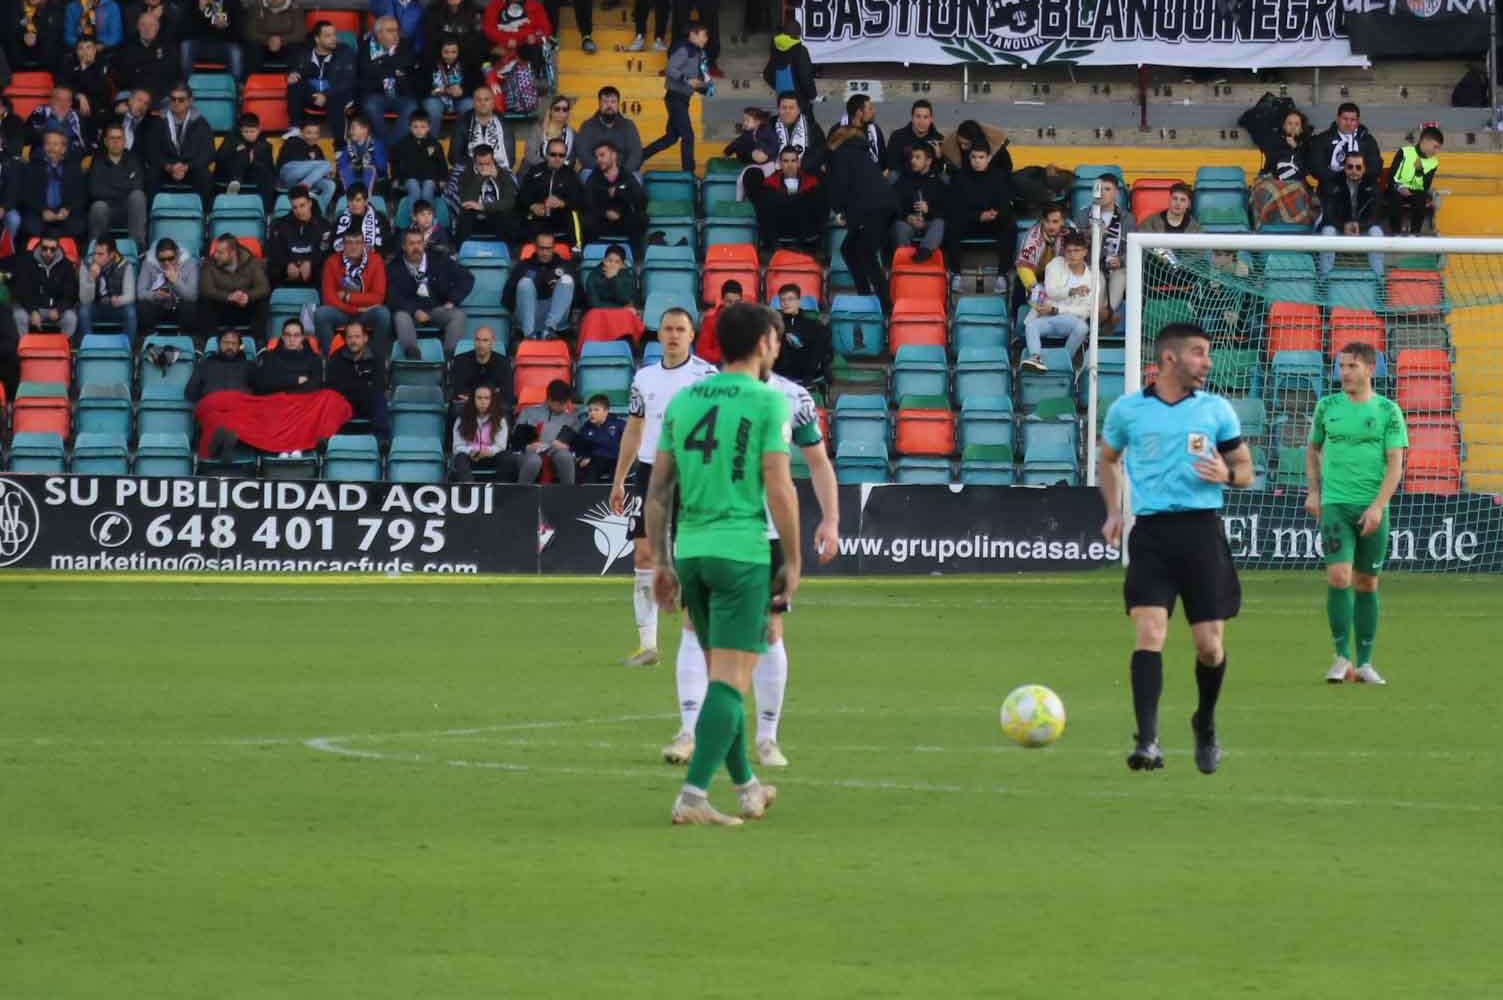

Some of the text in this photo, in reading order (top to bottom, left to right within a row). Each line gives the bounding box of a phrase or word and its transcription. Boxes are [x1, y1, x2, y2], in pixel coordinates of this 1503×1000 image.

[45, 478, 494, 515] SU PUBLICIDAD AQUÍ
[146, 514, 446, 552] 648 401 795
[1428, 517, 1478, 561] de
[51, 551, 478, 574] marketing@salamancacfudscom
